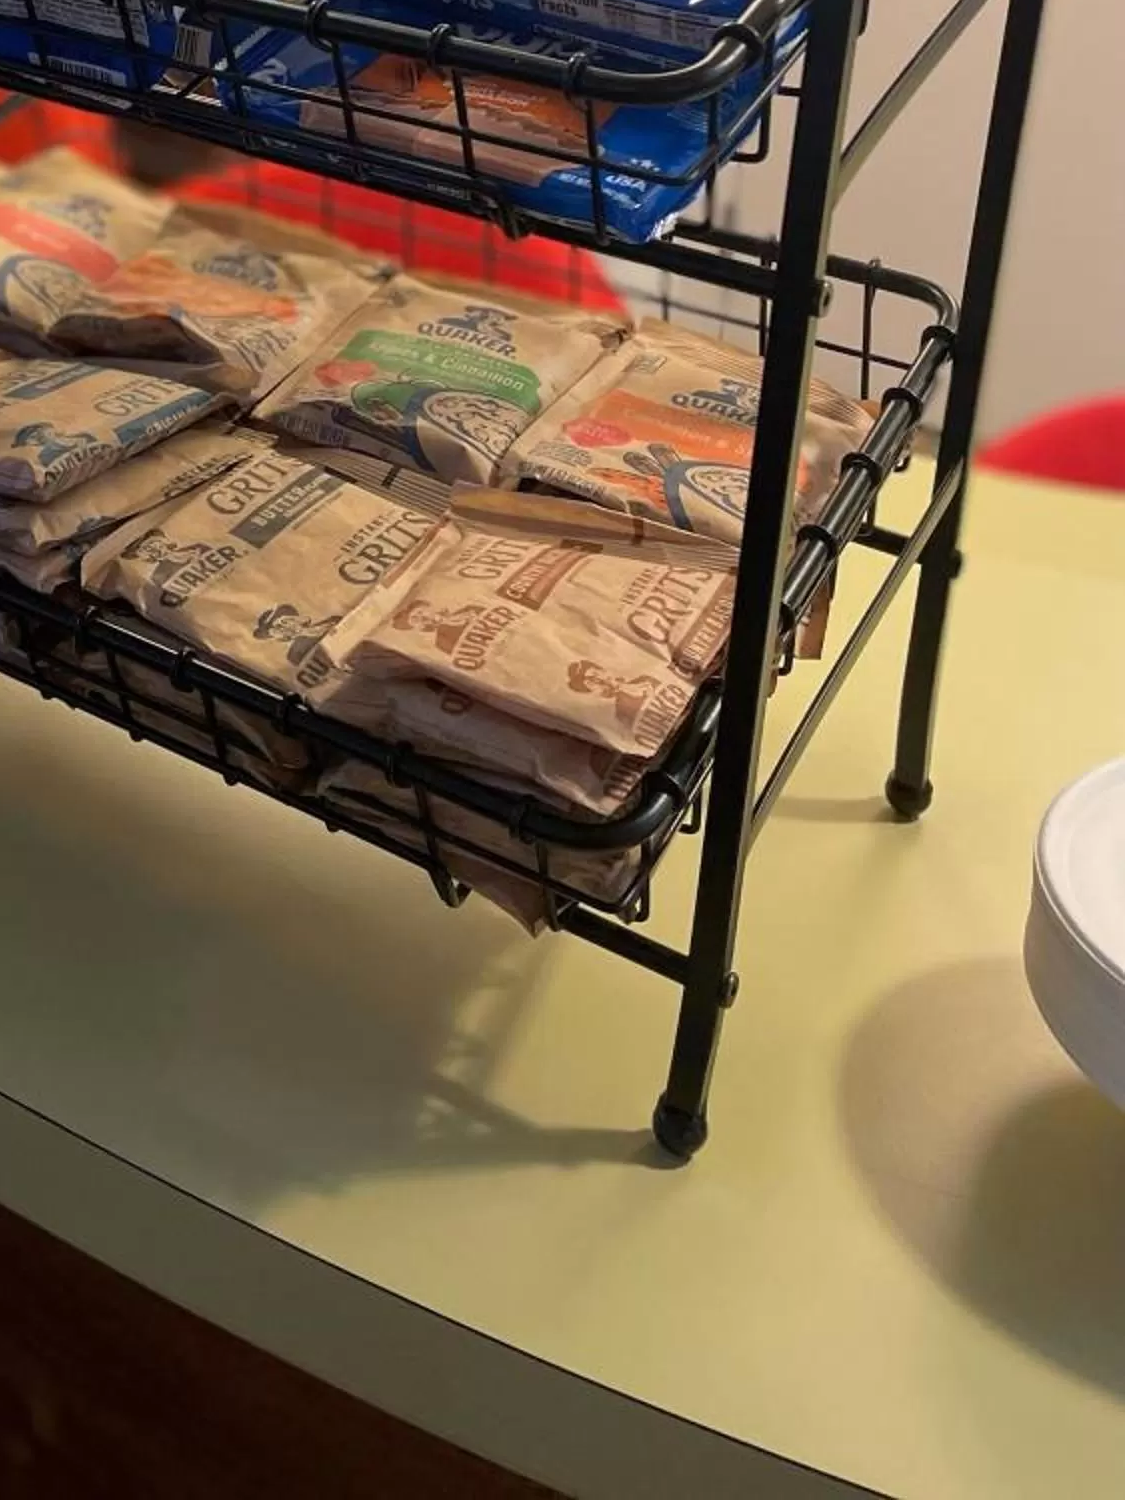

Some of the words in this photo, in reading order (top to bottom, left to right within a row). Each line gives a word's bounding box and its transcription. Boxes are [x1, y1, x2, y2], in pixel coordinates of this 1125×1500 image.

[417, 322, 517, 358] QUAKER
[250, 484, 307, 528] BUTTER
[339, 511, 389, 554] INSTANT
[159, 544, 238, 609] QUAKER
[337, 510, 437, 586] GRITS
[452, 604, 520, 672] QUAKER
[626, 567, 715, 647] GRITS
